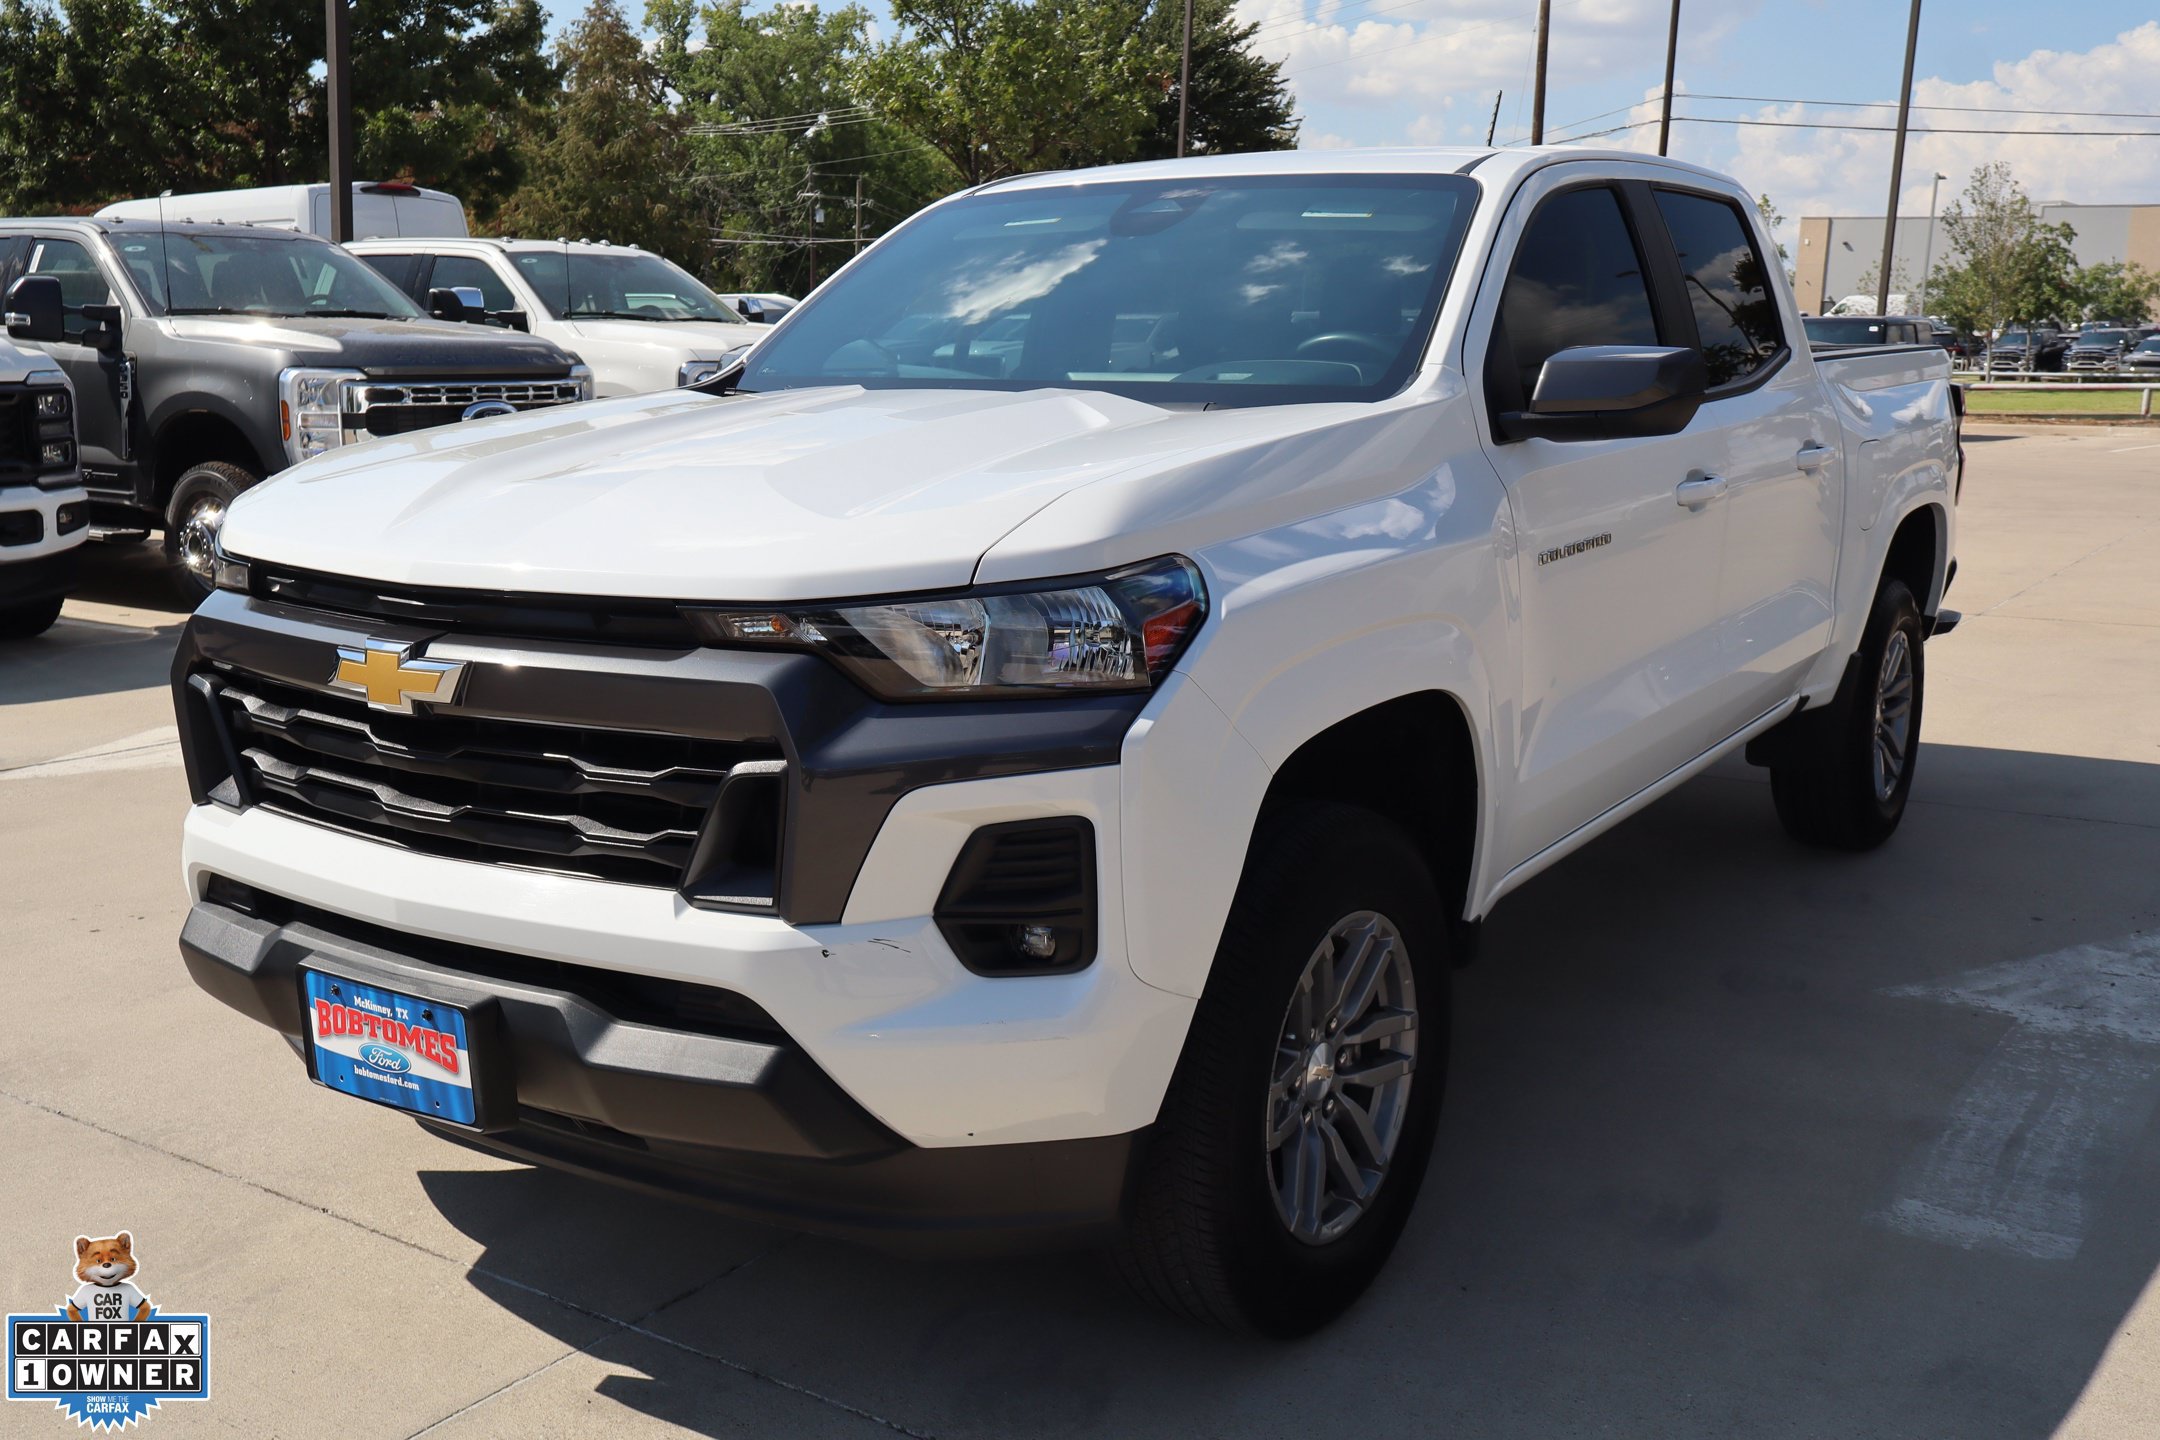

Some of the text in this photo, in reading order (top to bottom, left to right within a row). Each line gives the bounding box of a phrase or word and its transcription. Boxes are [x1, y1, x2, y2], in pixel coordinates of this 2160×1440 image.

[353, 995, 409, 1020] McKinney, TX
[368, 1047, 402, 1071] Ford
[353, 1064, 420, 1091] bobtomesford.com
